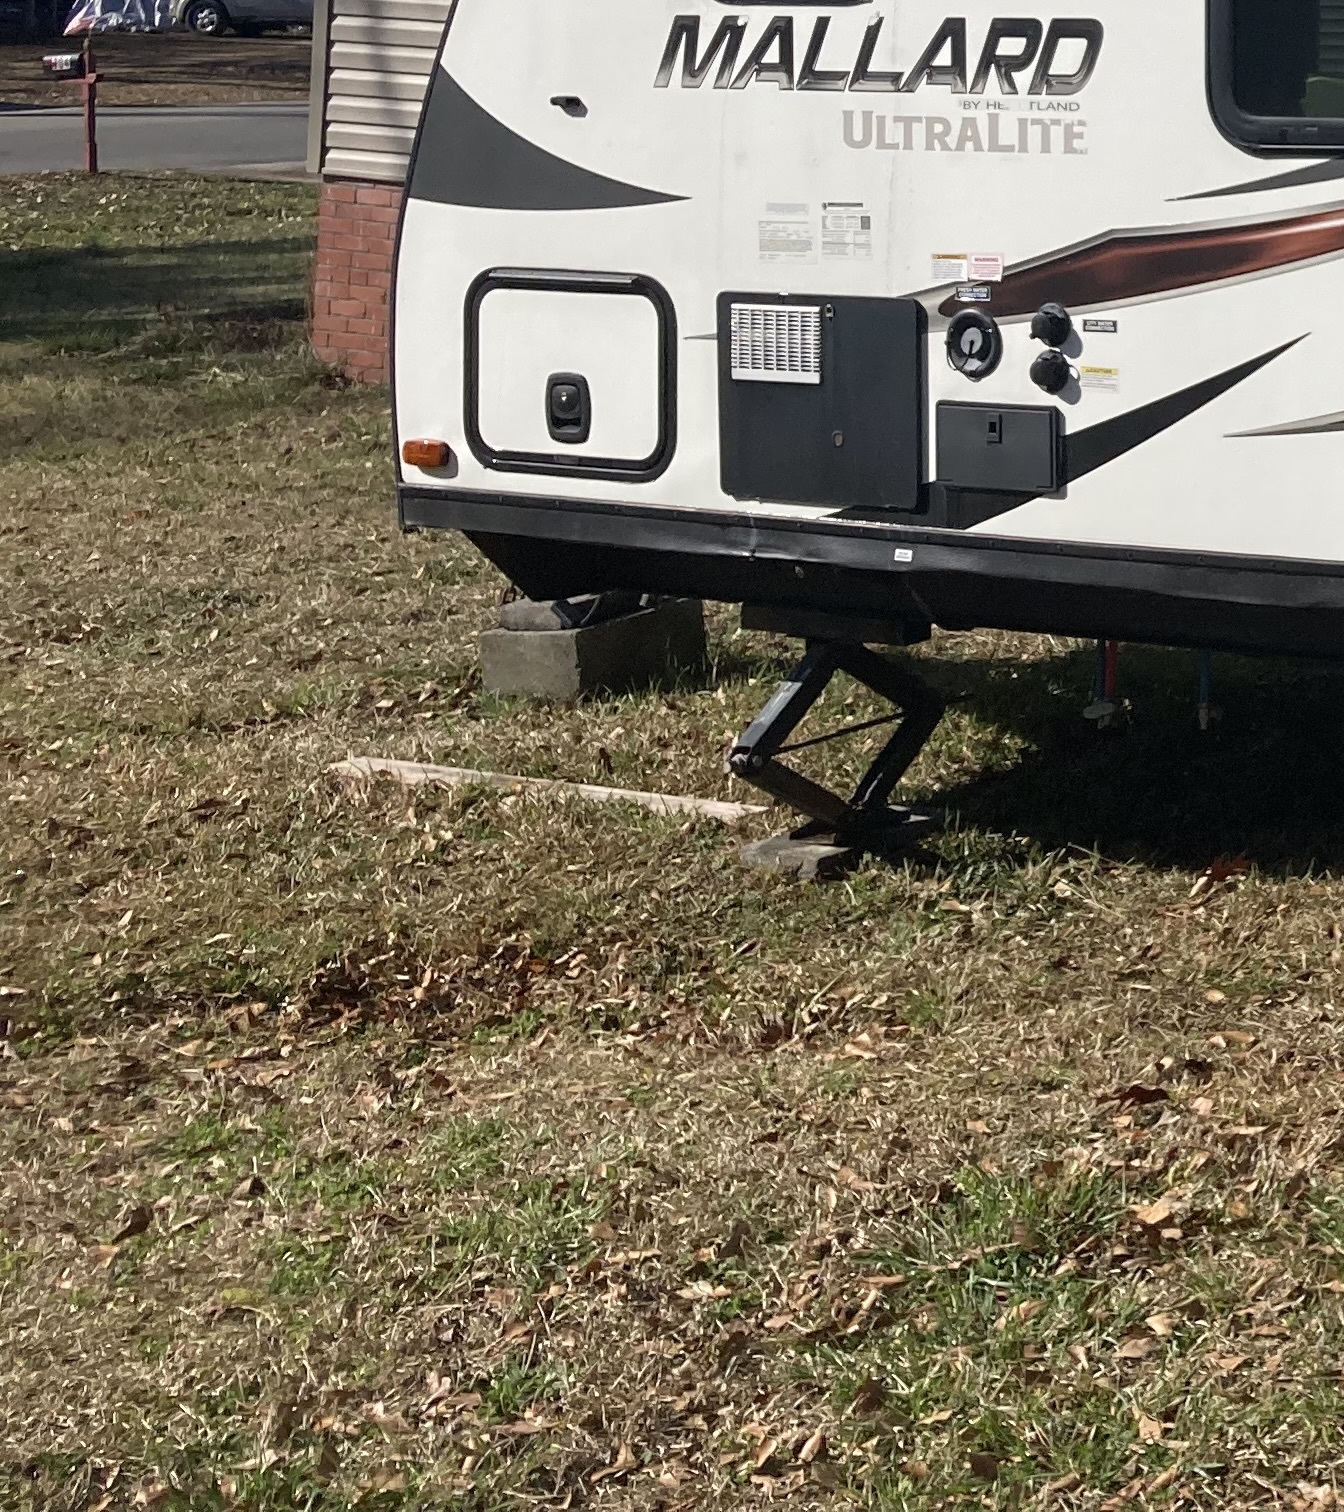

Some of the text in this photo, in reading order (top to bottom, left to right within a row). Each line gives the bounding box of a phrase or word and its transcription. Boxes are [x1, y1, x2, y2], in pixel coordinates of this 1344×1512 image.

[653, 14, 1104, 96] MALLARD
[963, 100, 1080, 112] BY HETLAND
